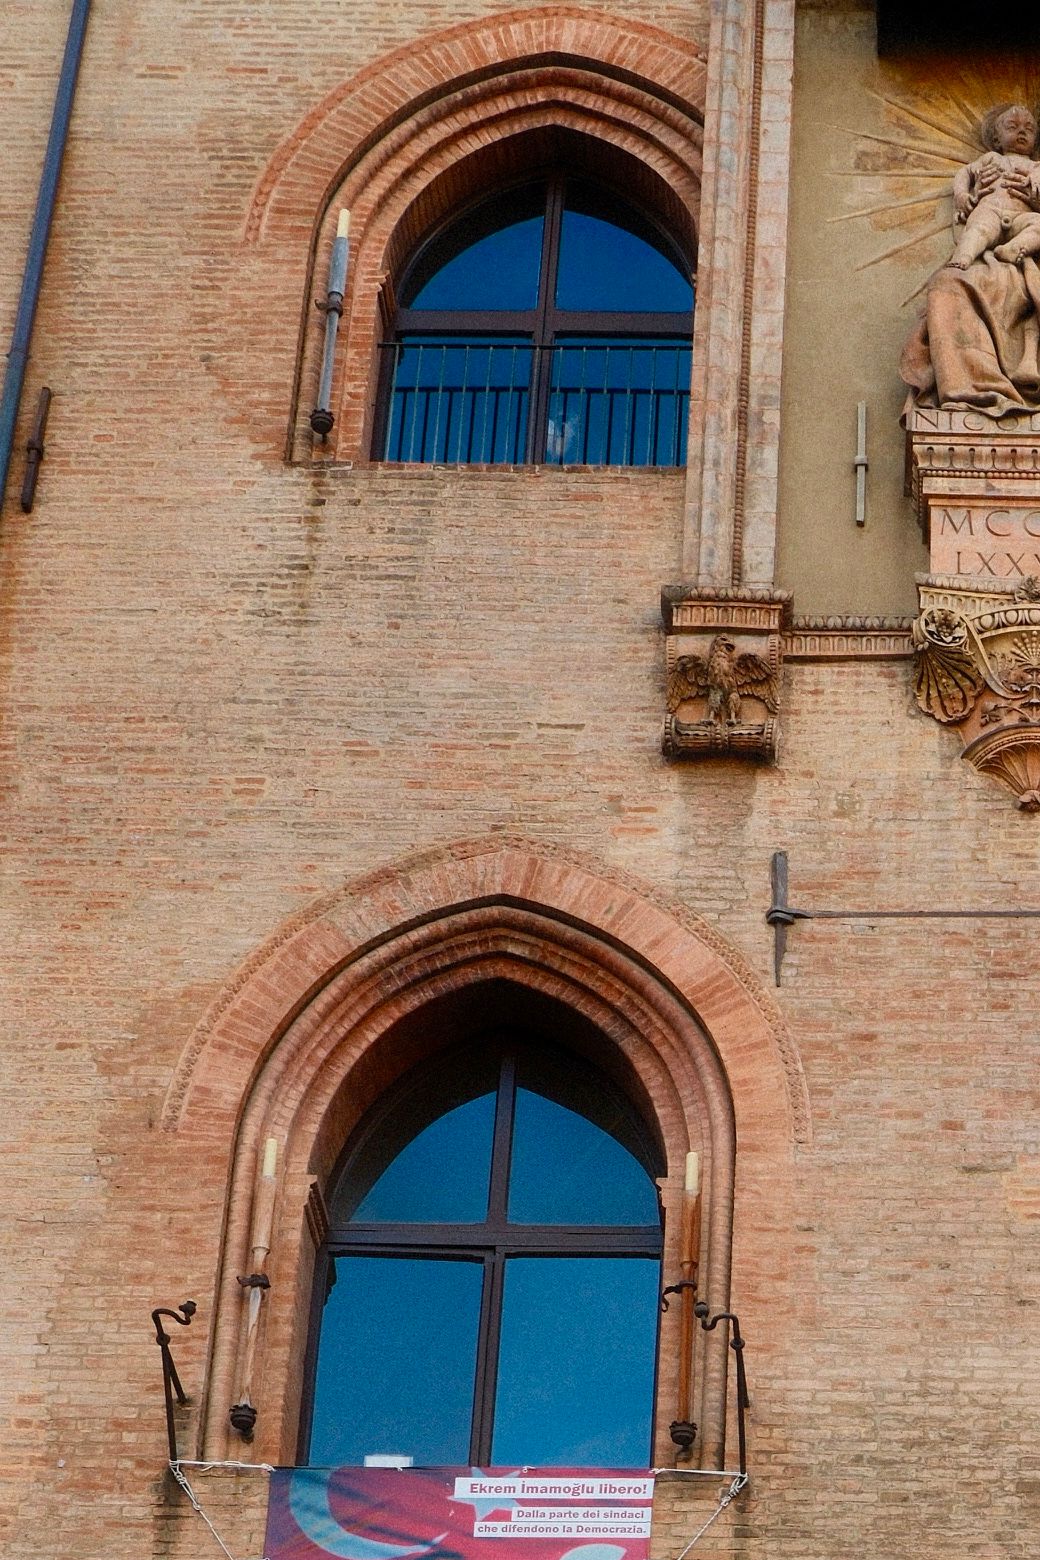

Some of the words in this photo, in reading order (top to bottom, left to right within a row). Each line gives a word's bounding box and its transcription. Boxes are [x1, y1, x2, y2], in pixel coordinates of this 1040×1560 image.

[470, 1483, 516, 1494] Ekrem
[521, 1480, 594, 1496] İmamoğlu
[599, 1483, 647, 1494] libero!
[517, 1510, 545, 1519] Dalla
[549, 1511, 579, 1521] parte
[581, 1510, 600, 1519] dei
[603, 1510, 644, 1519] sindaci
[477, 1525, 498, 1533] che
[502, 1525, 559, 1533] difendono
[562, 1525, 573, 1533] la
[576, 1525, 646, 1534] Democrazia.
